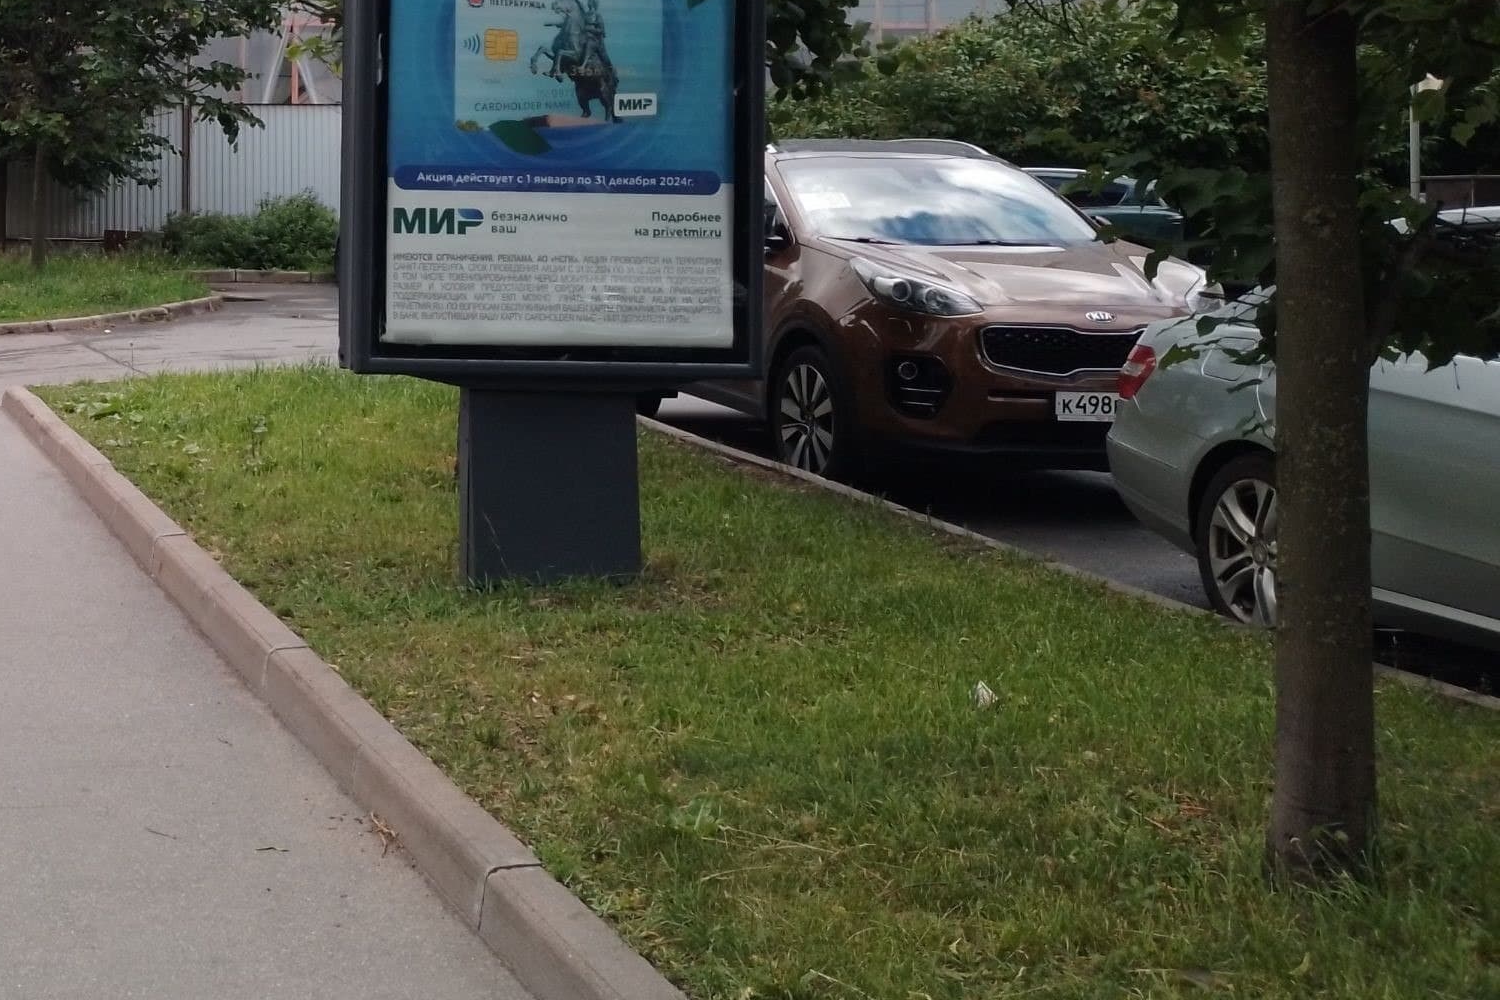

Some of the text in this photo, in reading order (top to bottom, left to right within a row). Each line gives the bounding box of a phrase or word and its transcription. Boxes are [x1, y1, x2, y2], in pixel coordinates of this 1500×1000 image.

[416, 171, 453, 184] Акция
[455, 172, 513, 185] действует
[516, 174, 523, 184] с
[525, 173, 531, 184] 1
[533, 175, 574, 187] января
[577, 176, 592, 185] по
[594, 175, 606, 185] 31
[608, 175, 657, 188] декабря
[392, 207, 484, 235] МИР
[491, 210, 568, 222] безналично
[651, 211, 722, 224] Подробнее
[491, 224, 517, 234] ваш
[634, 227, 722, 239] на privetmir.ru
[1062, 394, 1118, 415] К498
